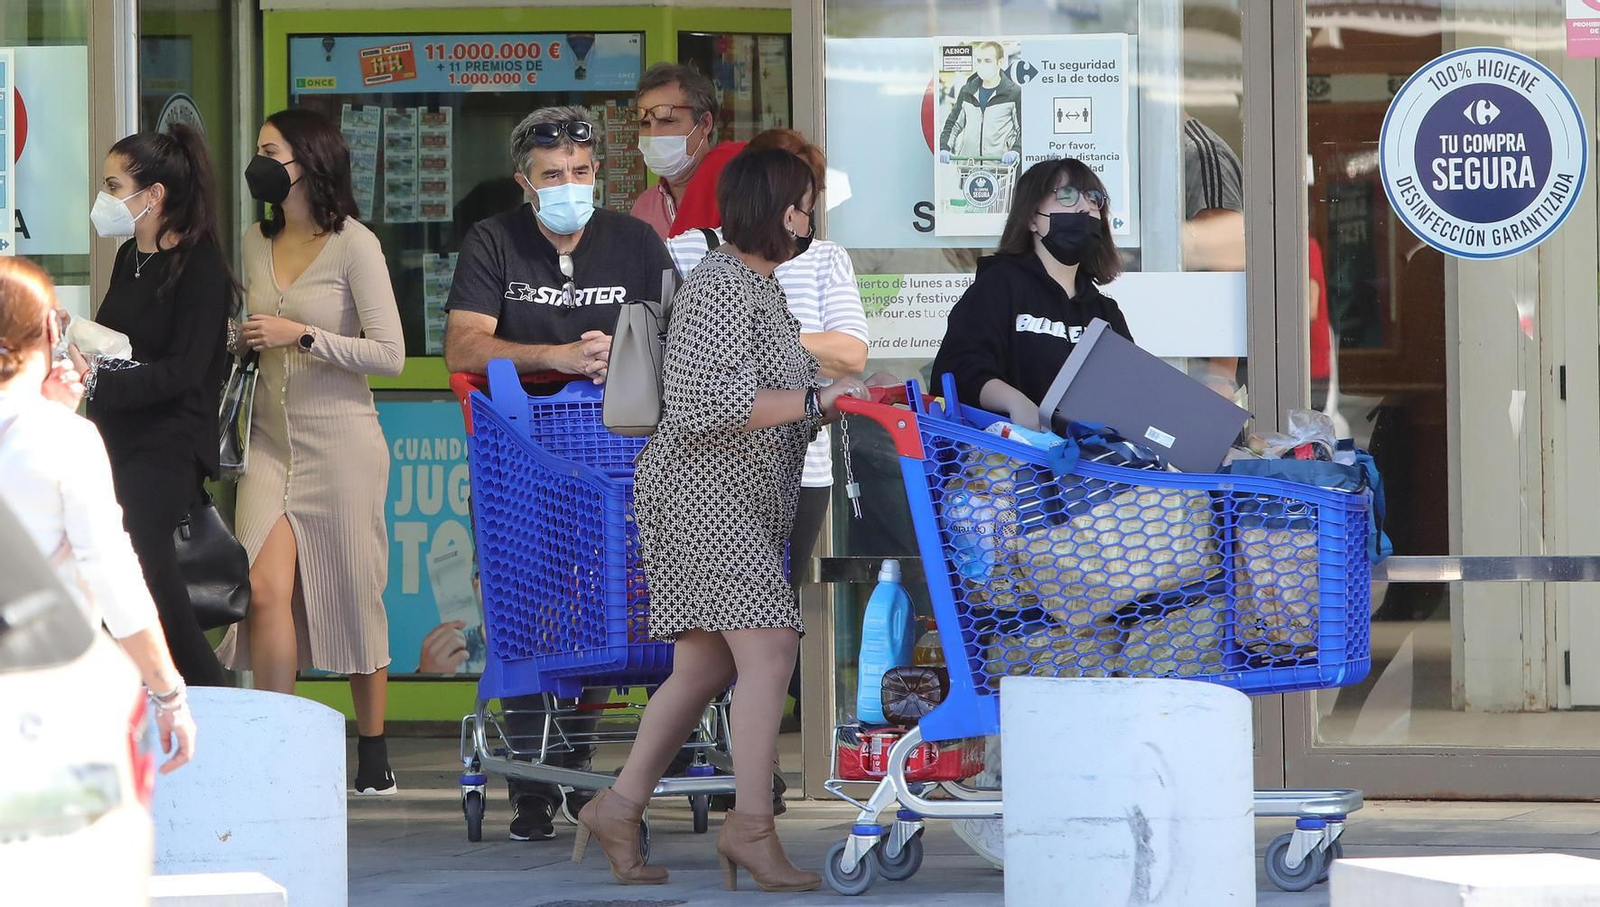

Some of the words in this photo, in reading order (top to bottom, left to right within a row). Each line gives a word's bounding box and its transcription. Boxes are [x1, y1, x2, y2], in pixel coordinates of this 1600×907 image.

[424, 42, 541, 60] 11.000.000
[548, 42, 561, 60] €
[449, 62, 460, 71] 11
[465, 61, 523, 72] PREMIOS
[526, 61, 543, 71] DE
[1041, 60, 1056, 70] Tu
[1059, 59, 1116, 72] seguridad
[307, 79, 334, 87] ONCE
[448, 72, 522, 85] 1.000.000
[526, 72, 537, 84] €
[1041, 75, 1054, 83] es
[1057, 73, 1067, 83] la
[1070, 73, 1084, 83] de
[1087, 73, 1120, 83] todos
[1428, 61, 1472, 92] 100%
[1477, 59, 1540, 94] HIGIENE
[1049, 141, 1065, 150] Por
[1069, 141, 1096, 150] favor,
[1439, 134, 1458, 154] TU
[1463, 132, 1526, 153] COMPRA
[1025, 152, 1062, 162] mantén
[1076, 152, 1120, 161] distancia
[1431, 155, 1536, 191] SEGURA
[1396, 175, 1486, 247] DESINFECCIÓN
[1492, 172, 1575, 247] GARANTIZADA
[892, 278, 907, 289] de
[910, 278, 943, 288] lunes
[945, 280, 952, 288] a
[954, 277, 975, 288] sáb
[860, 293, 904, 307] mingos
[906, 295, 915, 306] y
[924, 309, 936, 318] tu
[938, 310, 951, 318] co
[1015, 314, 1068, 341] BILLIE
[892, 337, 908, 348] de
[910, 337, 942, 348] lunes
[393, 438, 468, 461] CUAND
